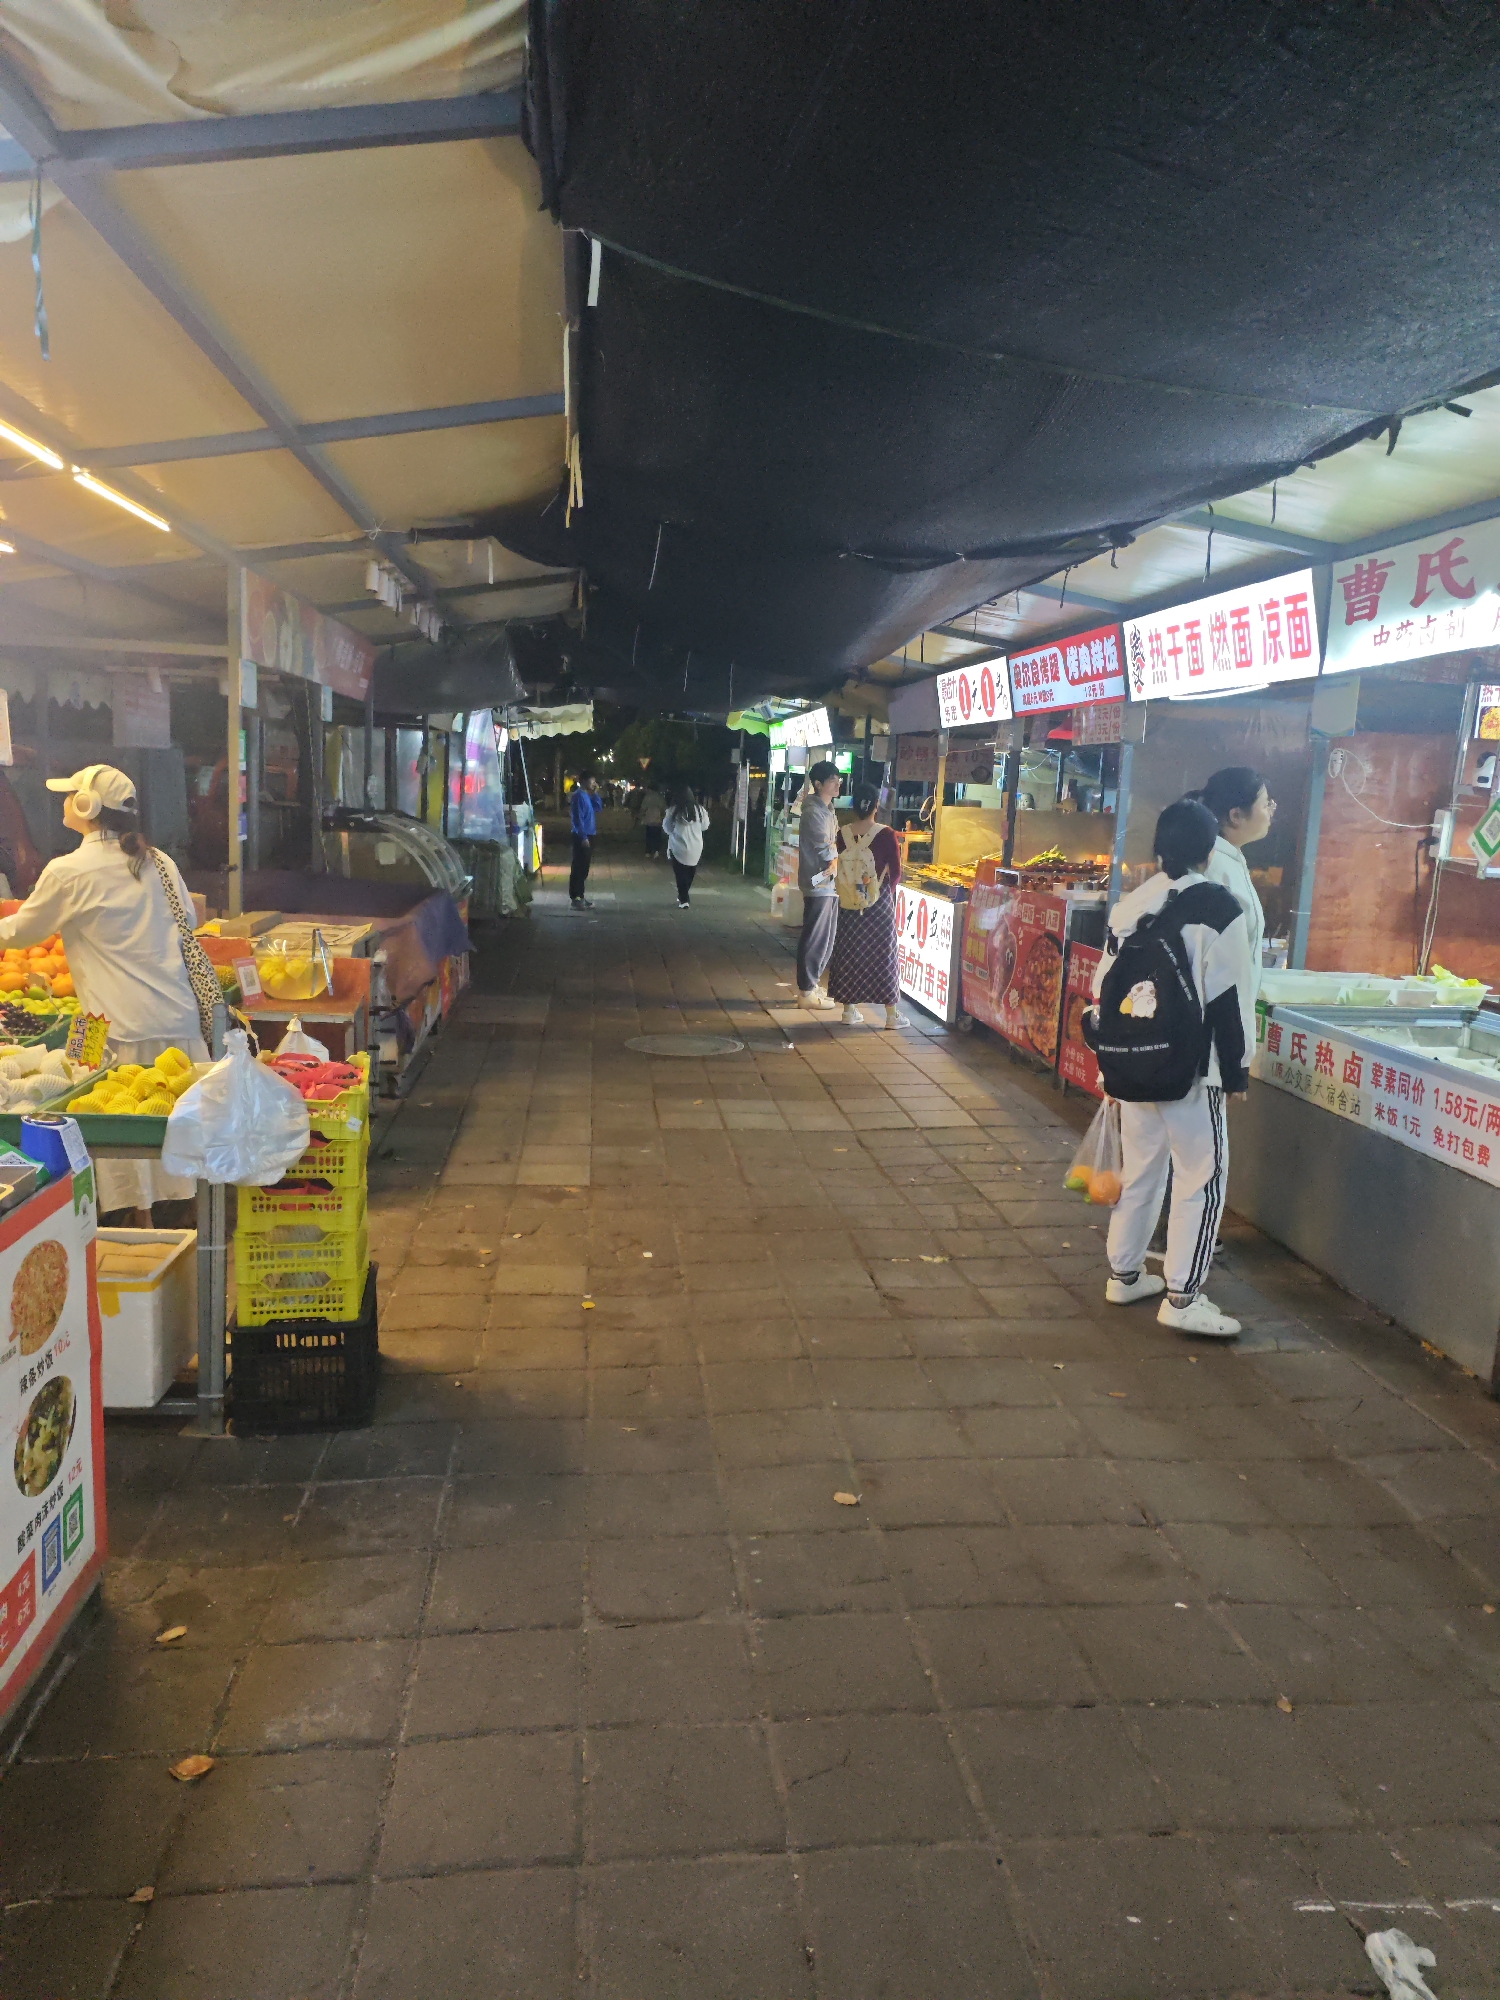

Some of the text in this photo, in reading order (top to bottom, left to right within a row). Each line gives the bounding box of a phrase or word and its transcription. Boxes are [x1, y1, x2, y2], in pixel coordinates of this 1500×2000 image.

[1337, 537, 1500, 627] 曹氏
[1149, 619, 1204, 685] 热干面
[1209, 607, 1253, 672] 燃面
[1259, 592, 1312, 665] 凉面
[68, 1017, 87, 1059] 新品上市
[1267, 1021, 1364, 1089] 曹氏热卤
[1371, 1062, 1500, 1137] 荤素同价 1.58元/两
[1374, 1101, 1491, 1168] 米饭 1元 免打包费
[67, 1457, 83, 1487] 12元
